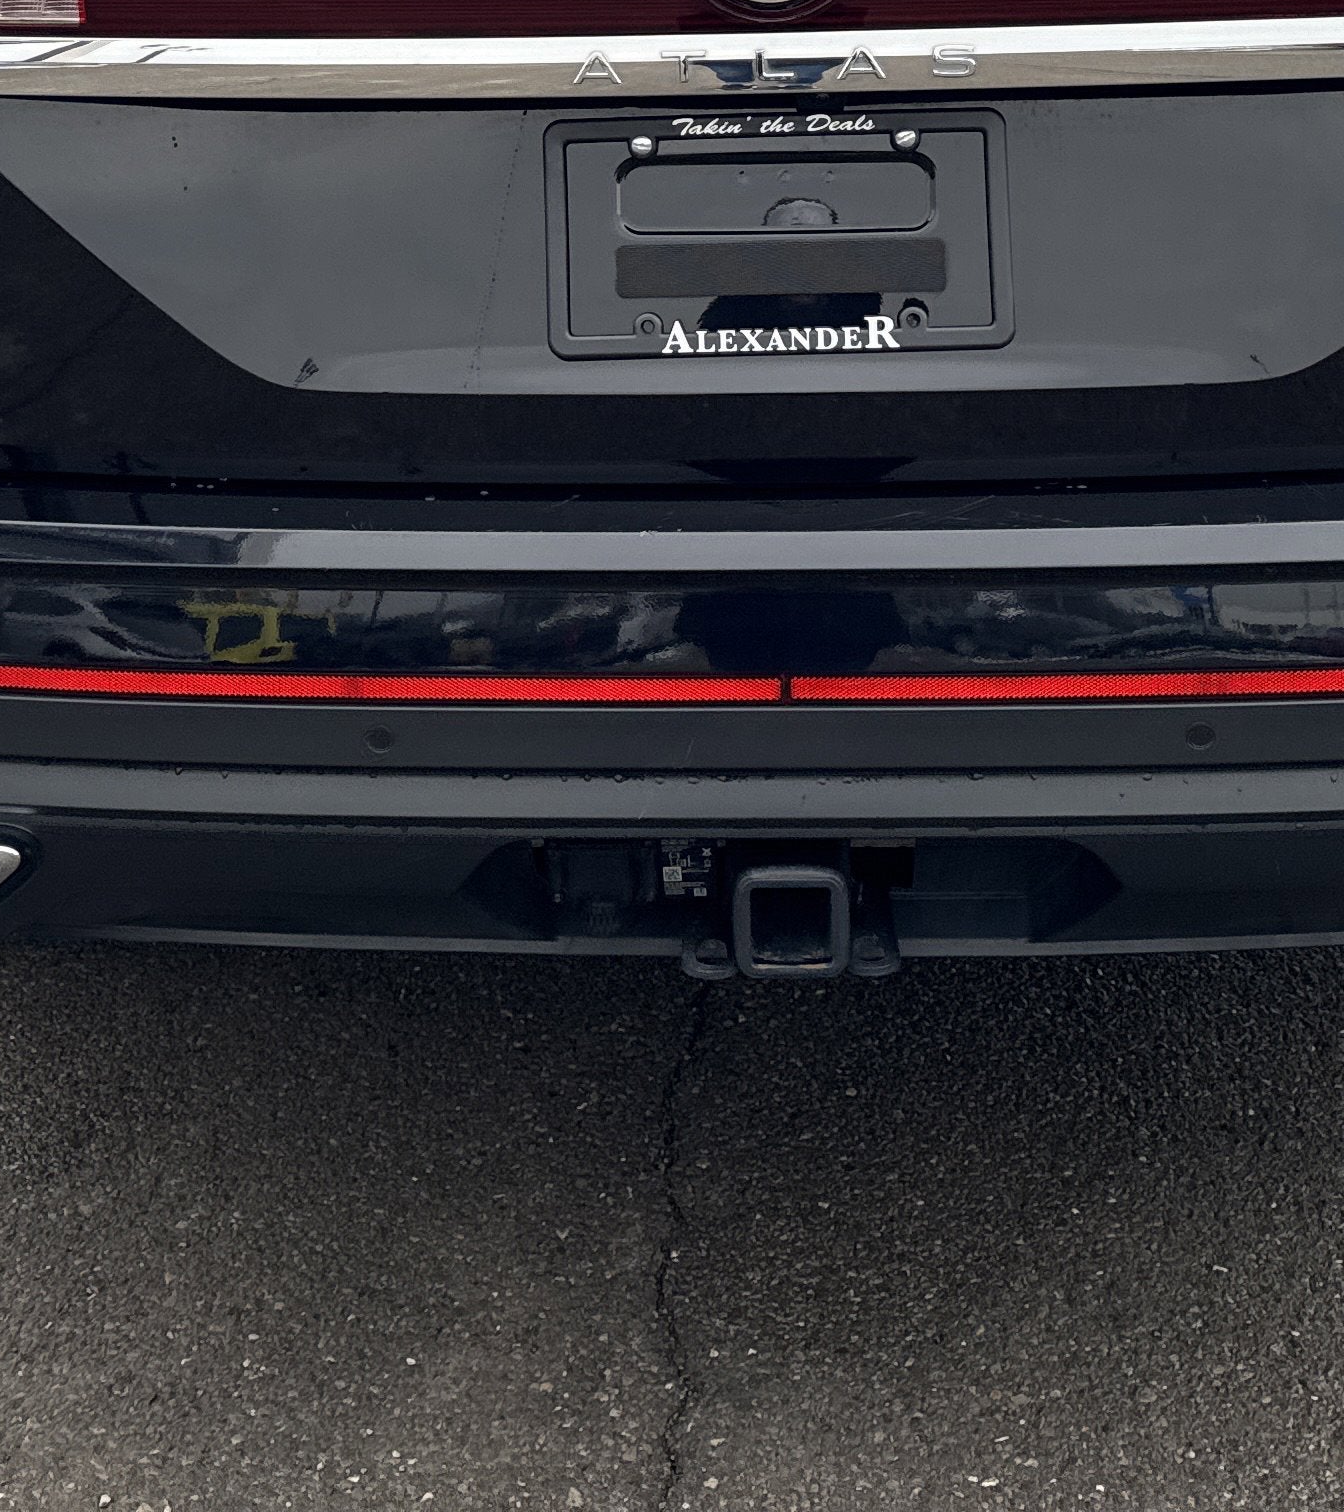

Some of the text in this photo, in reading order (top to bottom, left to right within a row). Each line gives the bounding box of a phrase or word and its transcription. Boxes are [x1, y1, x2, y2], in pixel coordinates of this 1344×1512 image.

[572, 44, 978, 86] ATLAS
[671, 113, 877, 136] Takin' the Deals
[661, 314, 901, 355] ALEXANDER
